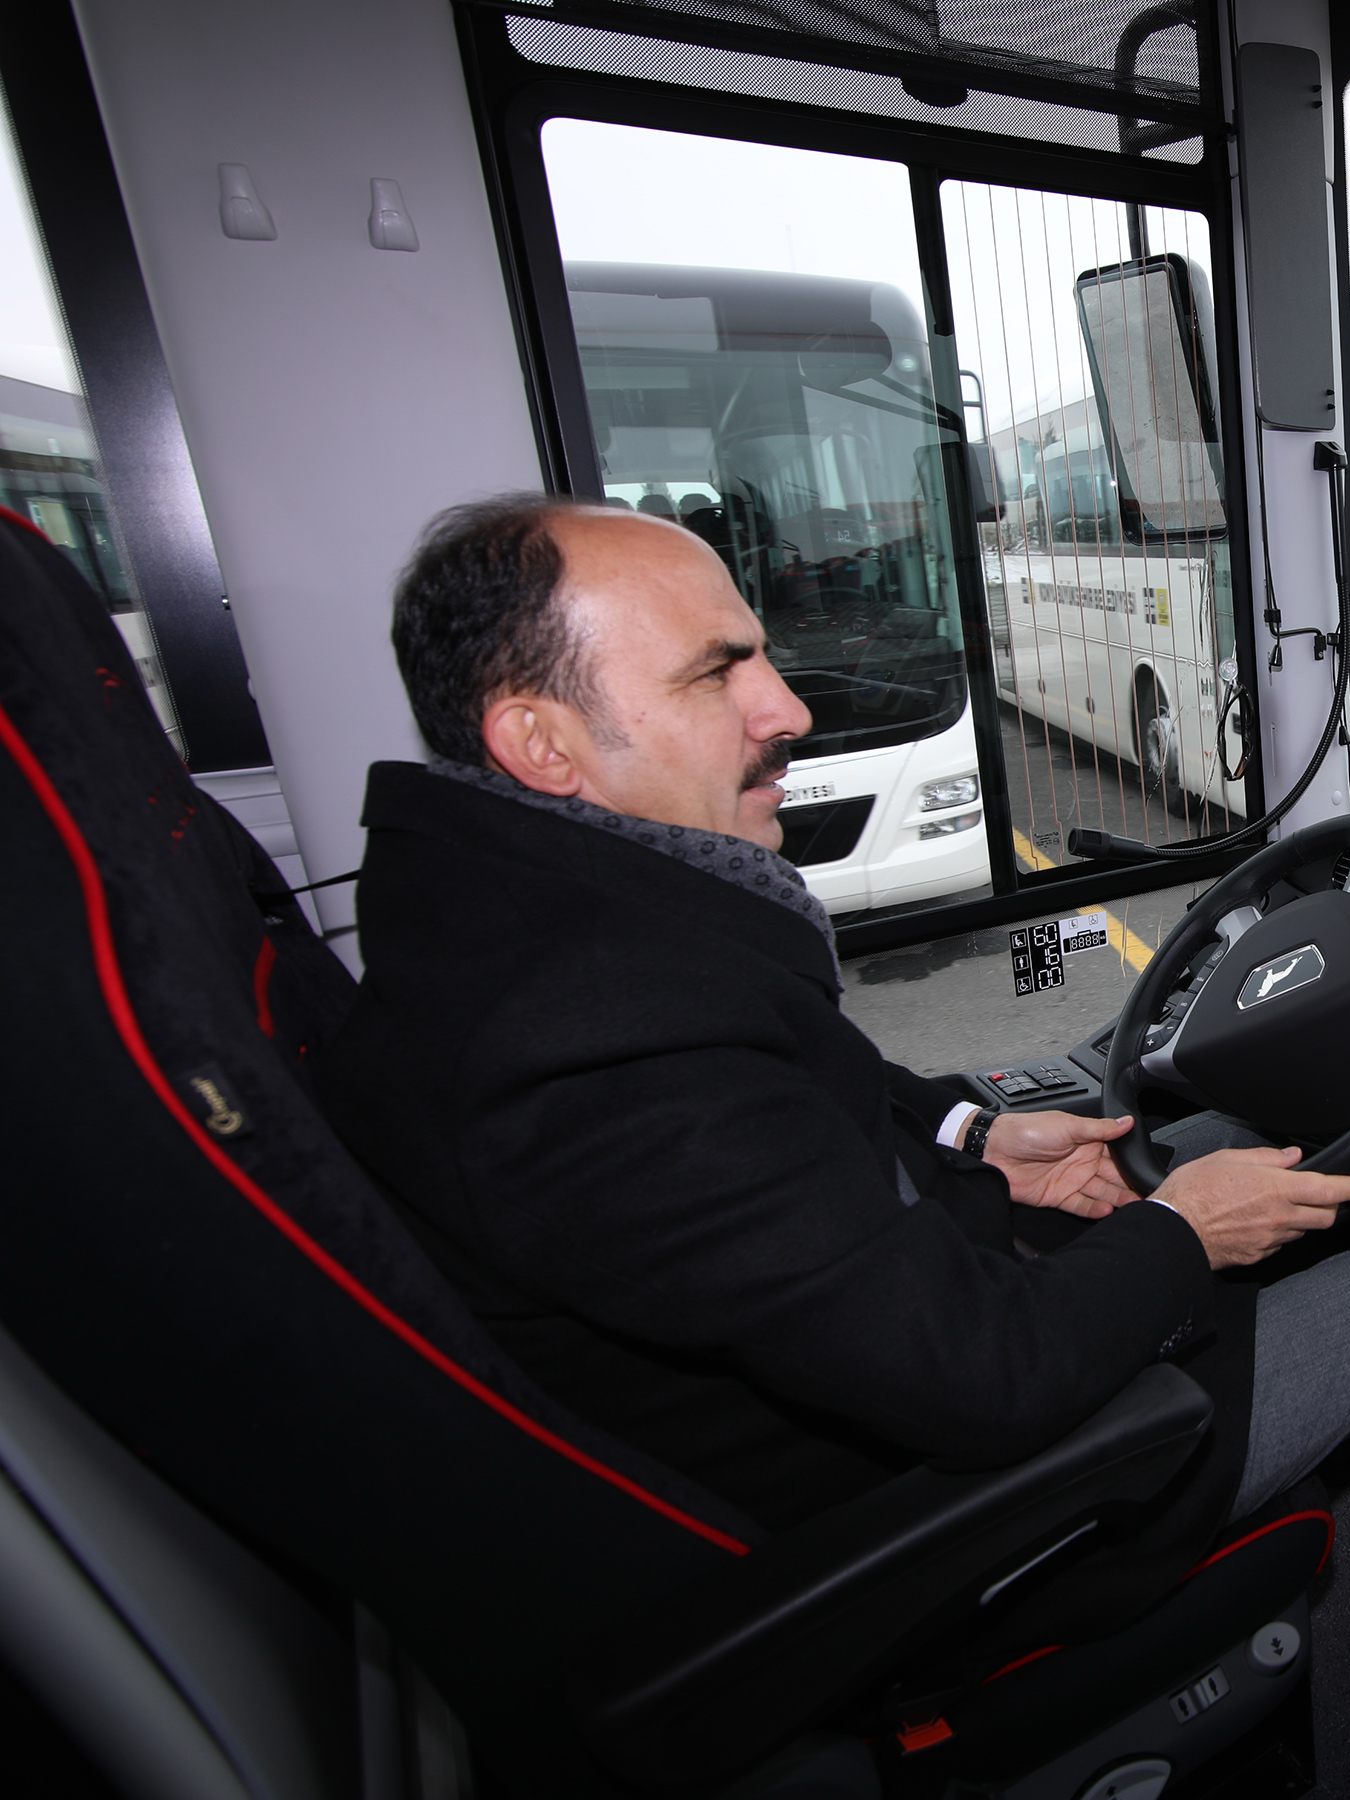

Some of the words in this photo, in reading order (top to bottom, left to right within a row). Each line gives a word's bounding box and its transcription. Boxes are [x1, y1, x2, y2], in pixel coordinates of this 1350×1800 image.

[1033, 923, 1058, 946] 60
[1071, 933, 1099, 950] 8888
[1044, 945, 1060, 965] 16
[1038, 966, 1062, 989] 00
